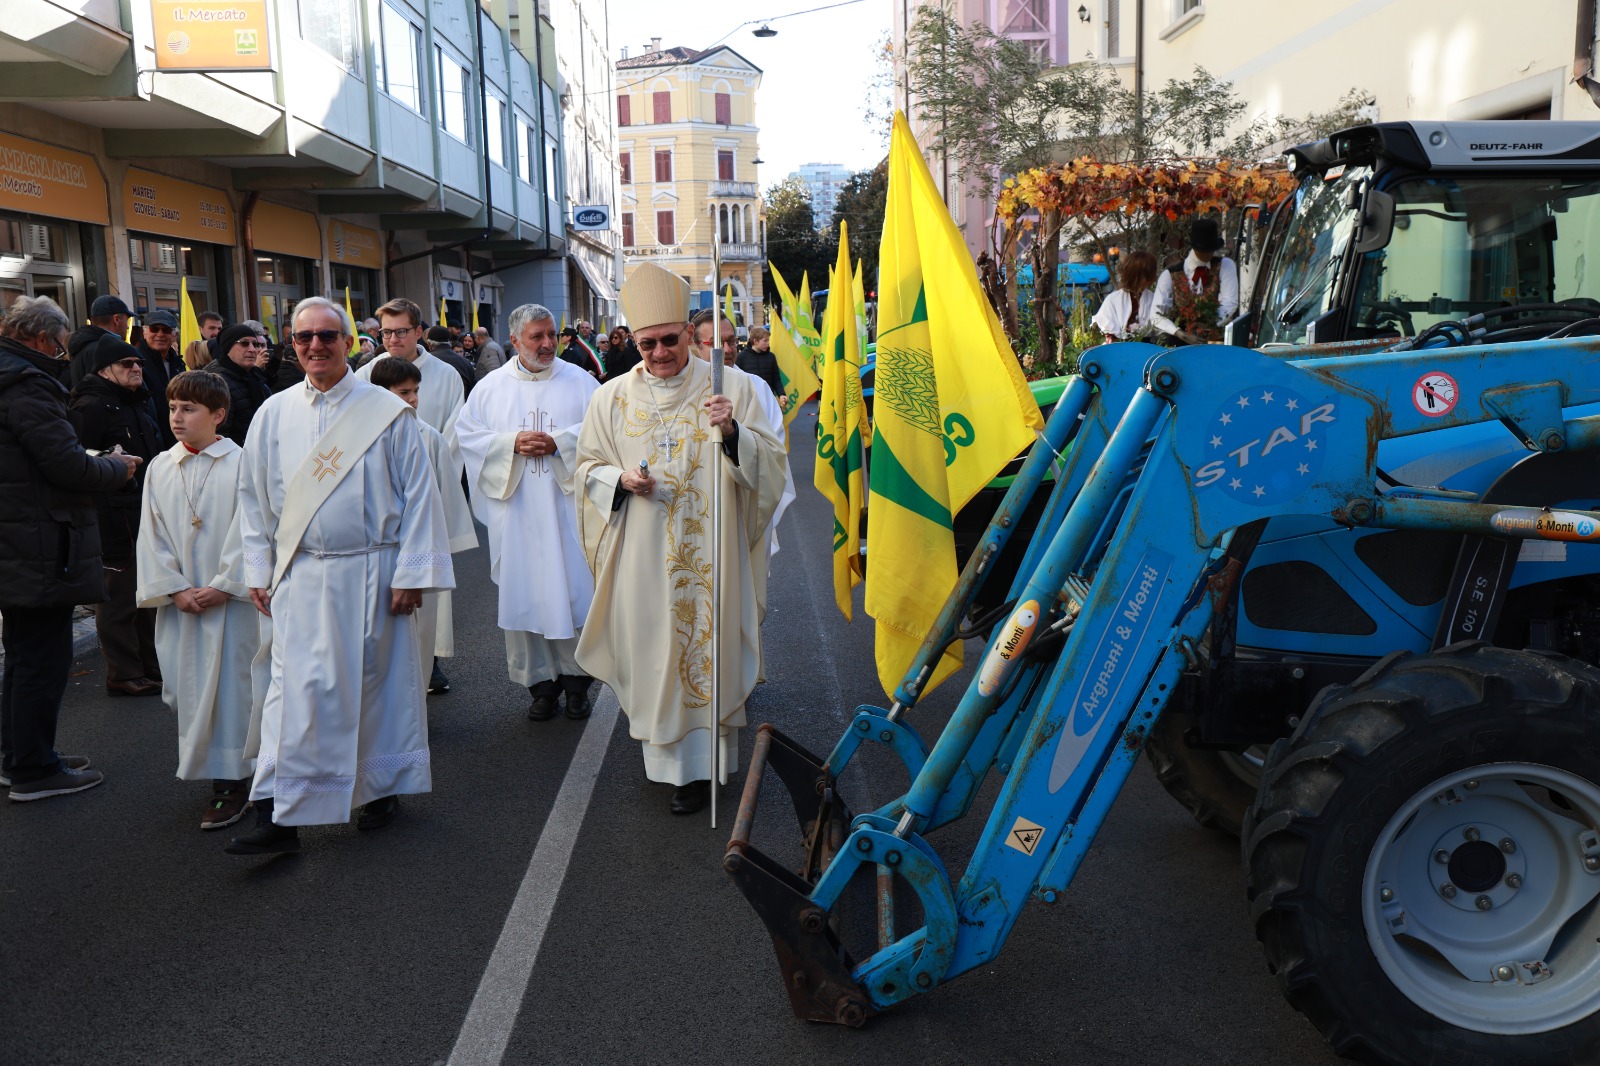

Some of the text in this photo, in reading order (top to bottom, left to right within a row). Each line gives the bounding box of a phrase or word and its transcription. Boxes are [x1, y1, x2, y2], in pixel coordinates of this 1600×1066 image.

[174, 8, 247, 21] Il Mercato
[0, 146, 87, 188] AMPAGNA AMICA
[4, 176, 42, 197] Mercato
[160, 207, 180, 221] SABATO
[1194, 403, 1336, 487] STAR
[1495, 513, 1534, 532] Argnani
[1545, 519, 1574, 532] Monti
[1462, 609, 1478, 633] 100
[1004, 626, 1025, 652] Monti
[1082, 564, 1159, 718] Argnani & Monti
[1000, 651, 1011, 660] &
